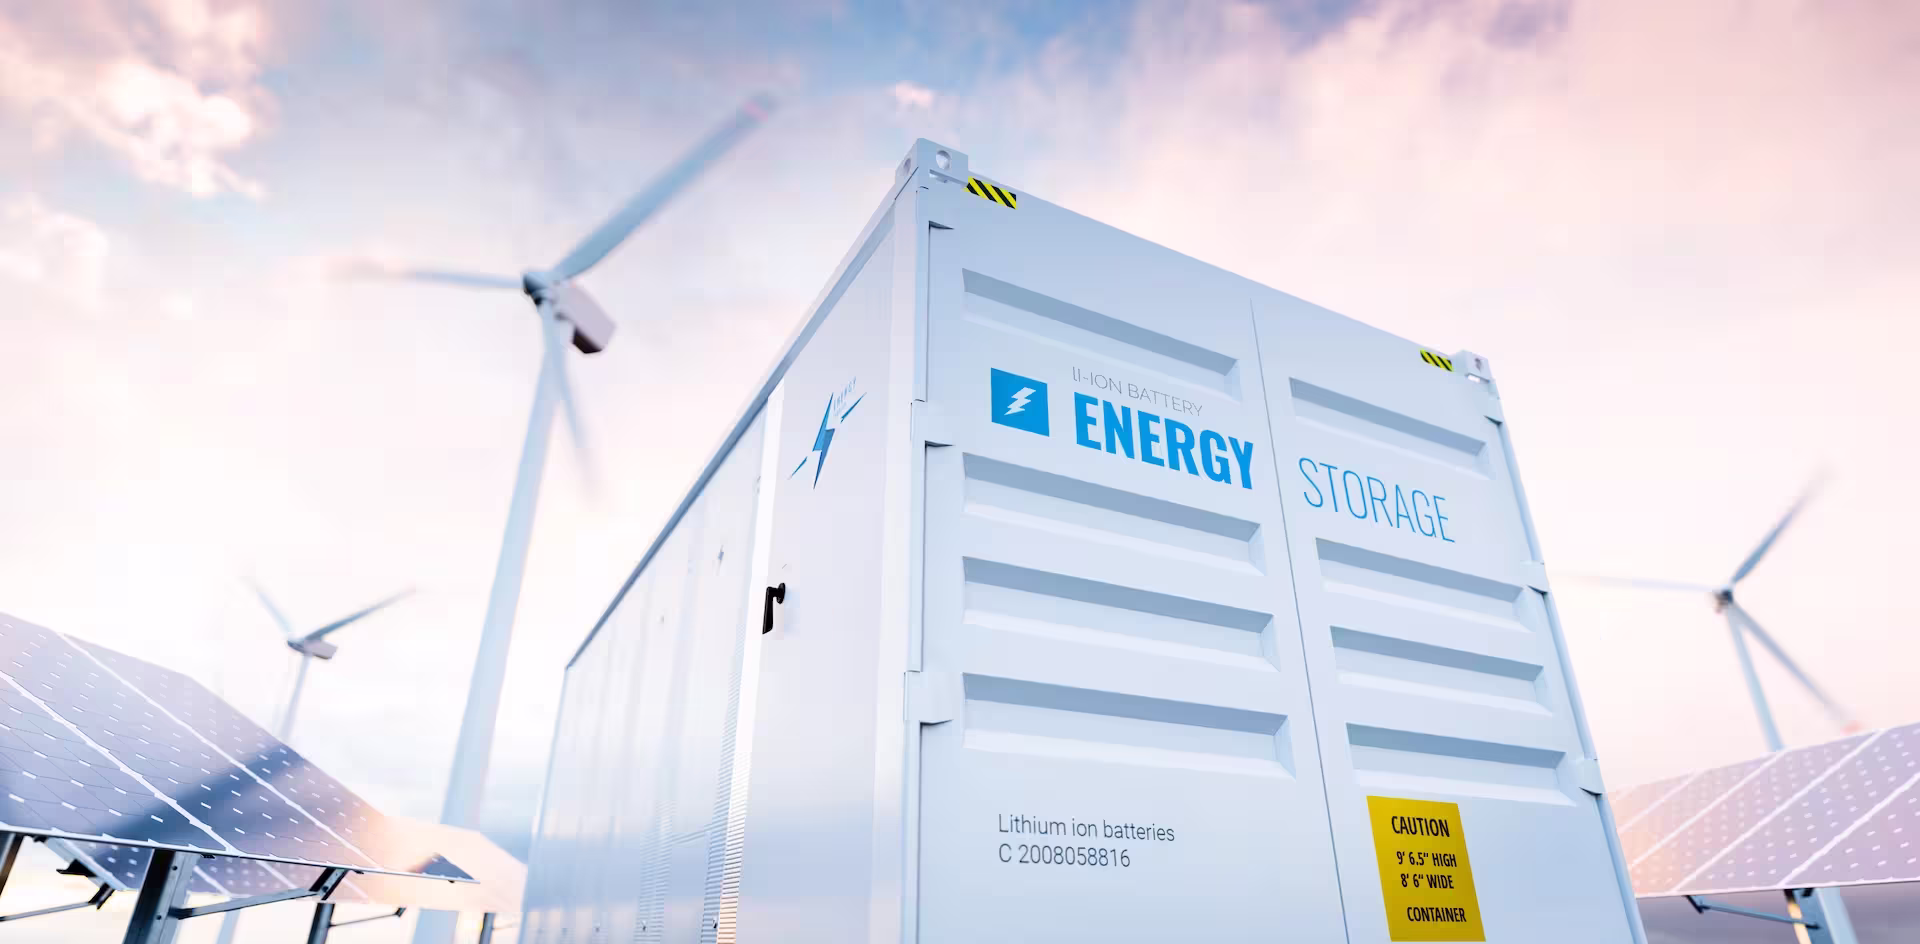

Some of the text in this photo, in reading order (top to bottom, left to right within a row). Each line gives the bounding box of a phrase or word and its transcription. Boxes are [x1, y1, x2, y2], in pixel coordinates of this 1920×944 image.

[1127, 382, 1203, 417] BATTERY
[1073, 391, 1456, 543] ENERGY STORAGE
[998, 813, 1175, 842] Lithium ion batteries
[1391, 815, 1450, 837] CAUTION
[999, 843, 1131, 868] C 2008058816
[1432, 853, 1458, 868] HIGH
[1426, 874, 1455, 889] WIDE
[1406, 906, 1467, 923] CONTAINER
